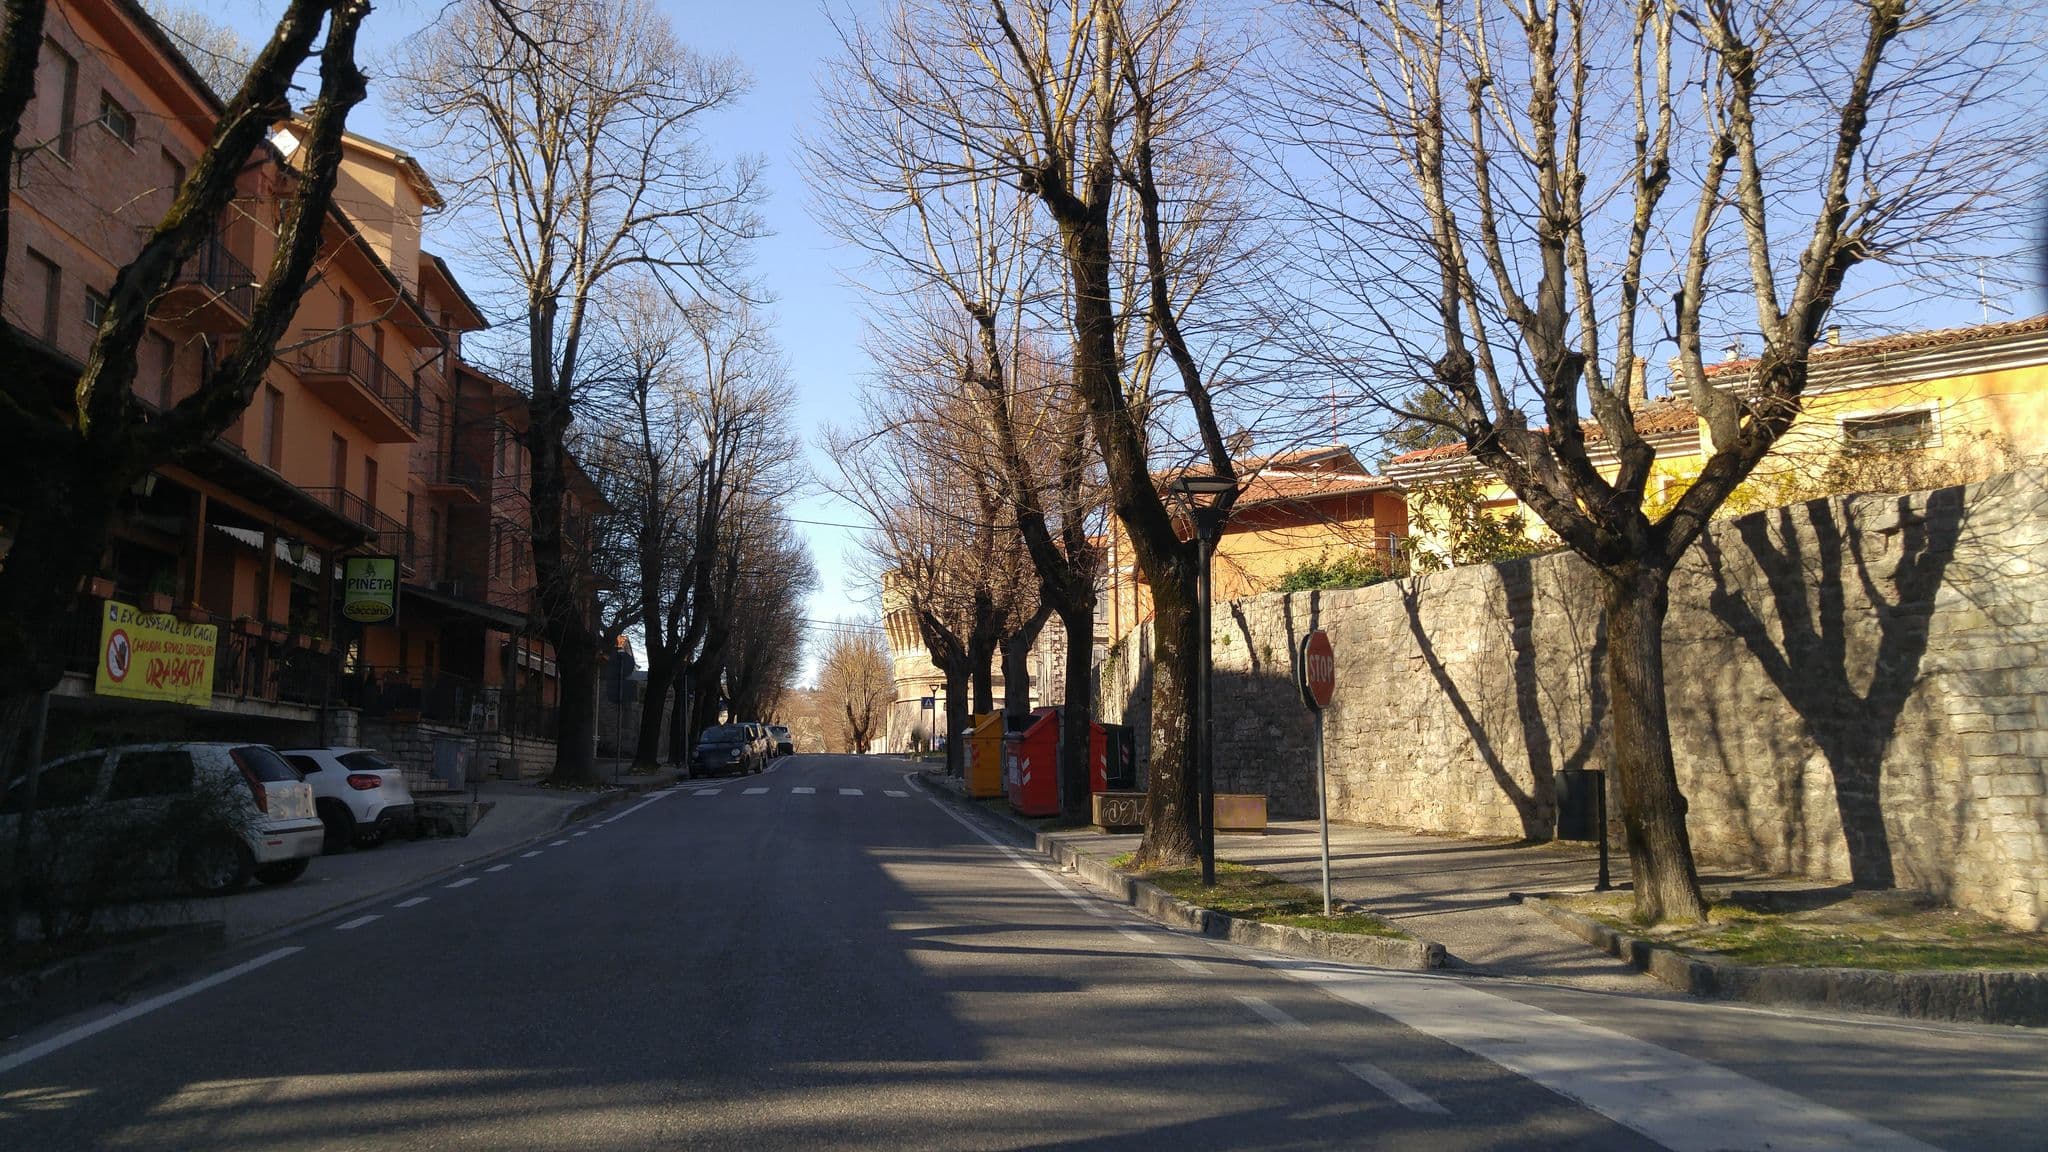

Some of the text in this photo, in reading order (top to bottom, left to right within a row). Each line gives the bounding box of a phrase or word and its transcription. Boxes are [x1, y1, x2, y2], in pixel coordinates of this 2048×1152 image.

[348, 578, 392, 590] PINETA
[120, 608, 135, 624] EX
[1309, 654, 1333, 682] STOP
